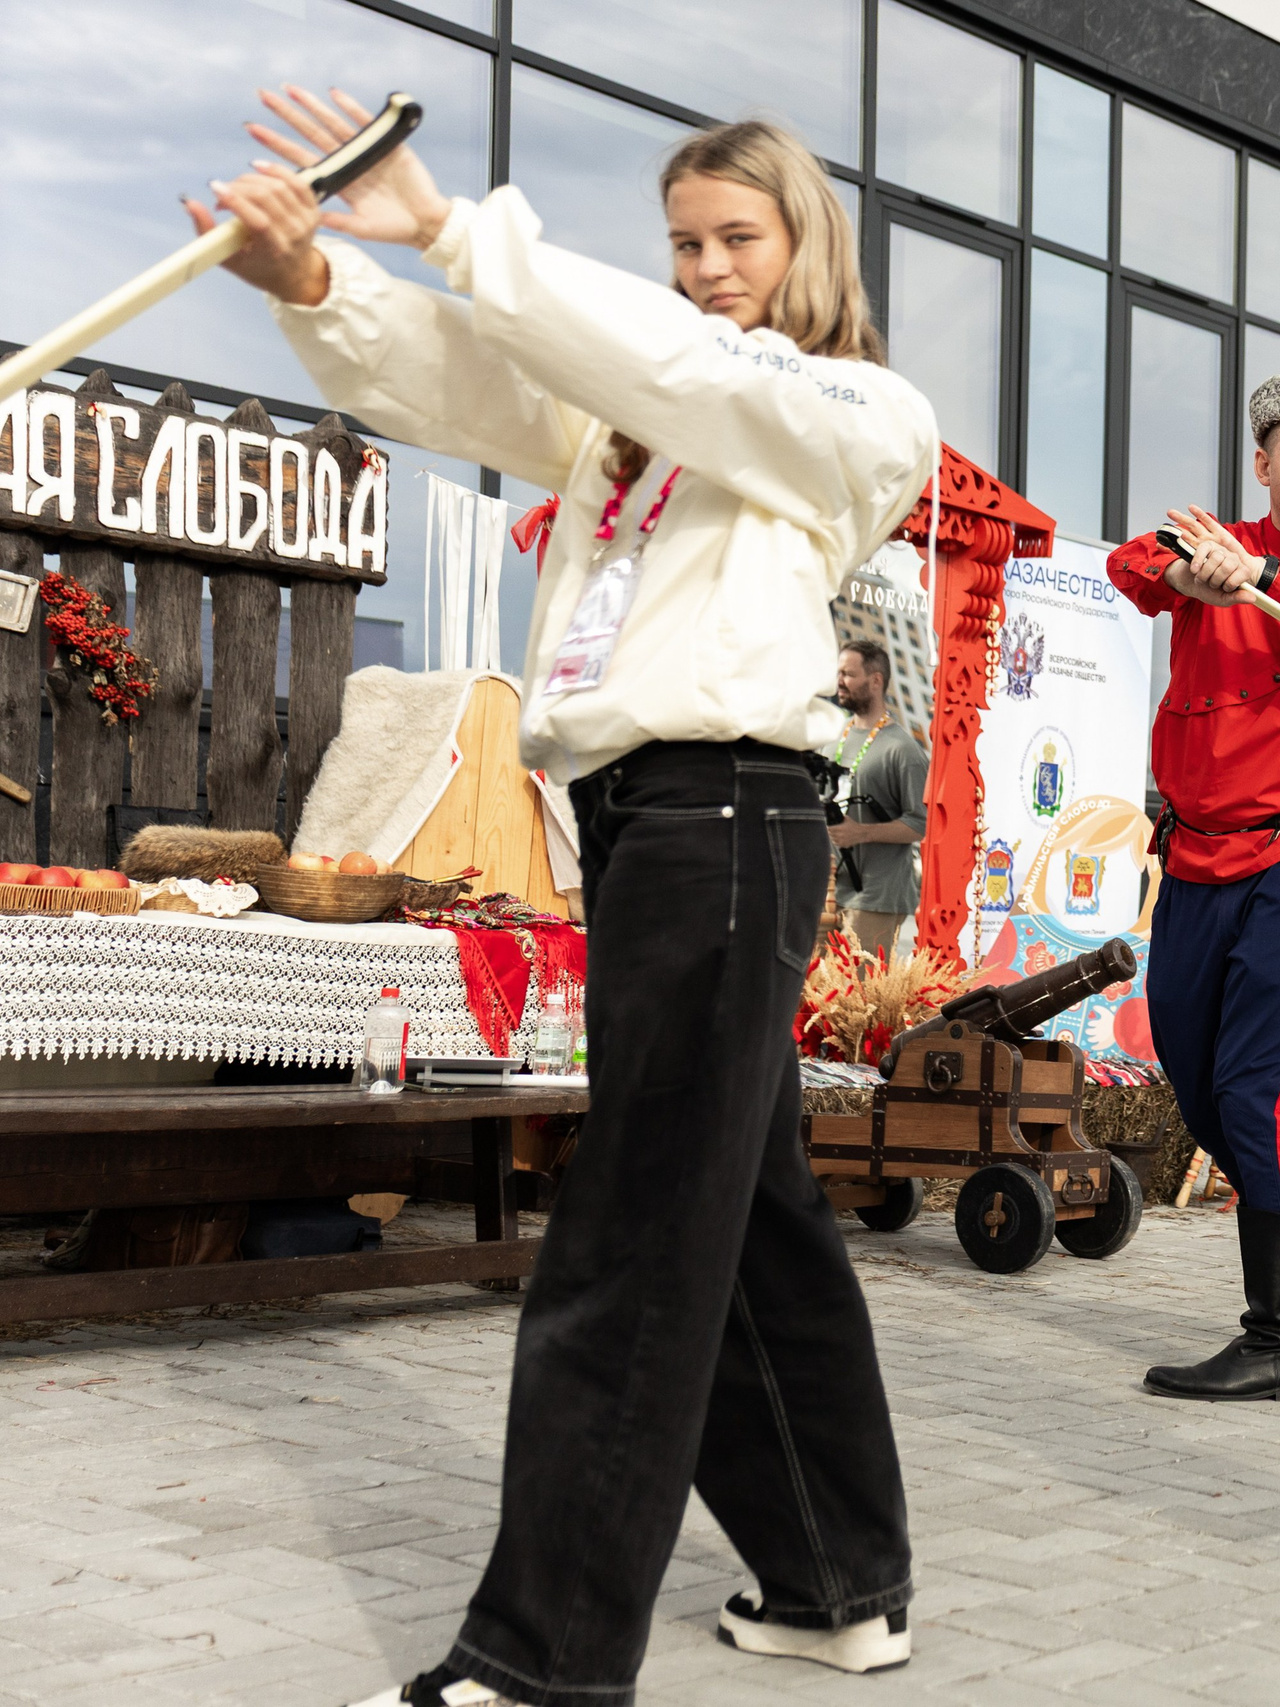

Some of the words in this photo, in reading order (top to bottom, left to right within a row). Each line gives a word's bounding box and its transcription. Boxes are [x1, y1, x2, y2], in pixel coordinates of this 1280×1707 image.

[96, 402, 388, 573] СЛОБОДА
[1022, 591, 1071, 611] Российского
[1049, 654, 1097, 670] ВСЕРОССИЙСКОЕ
[1060, 799, 1111, 825] слобода
